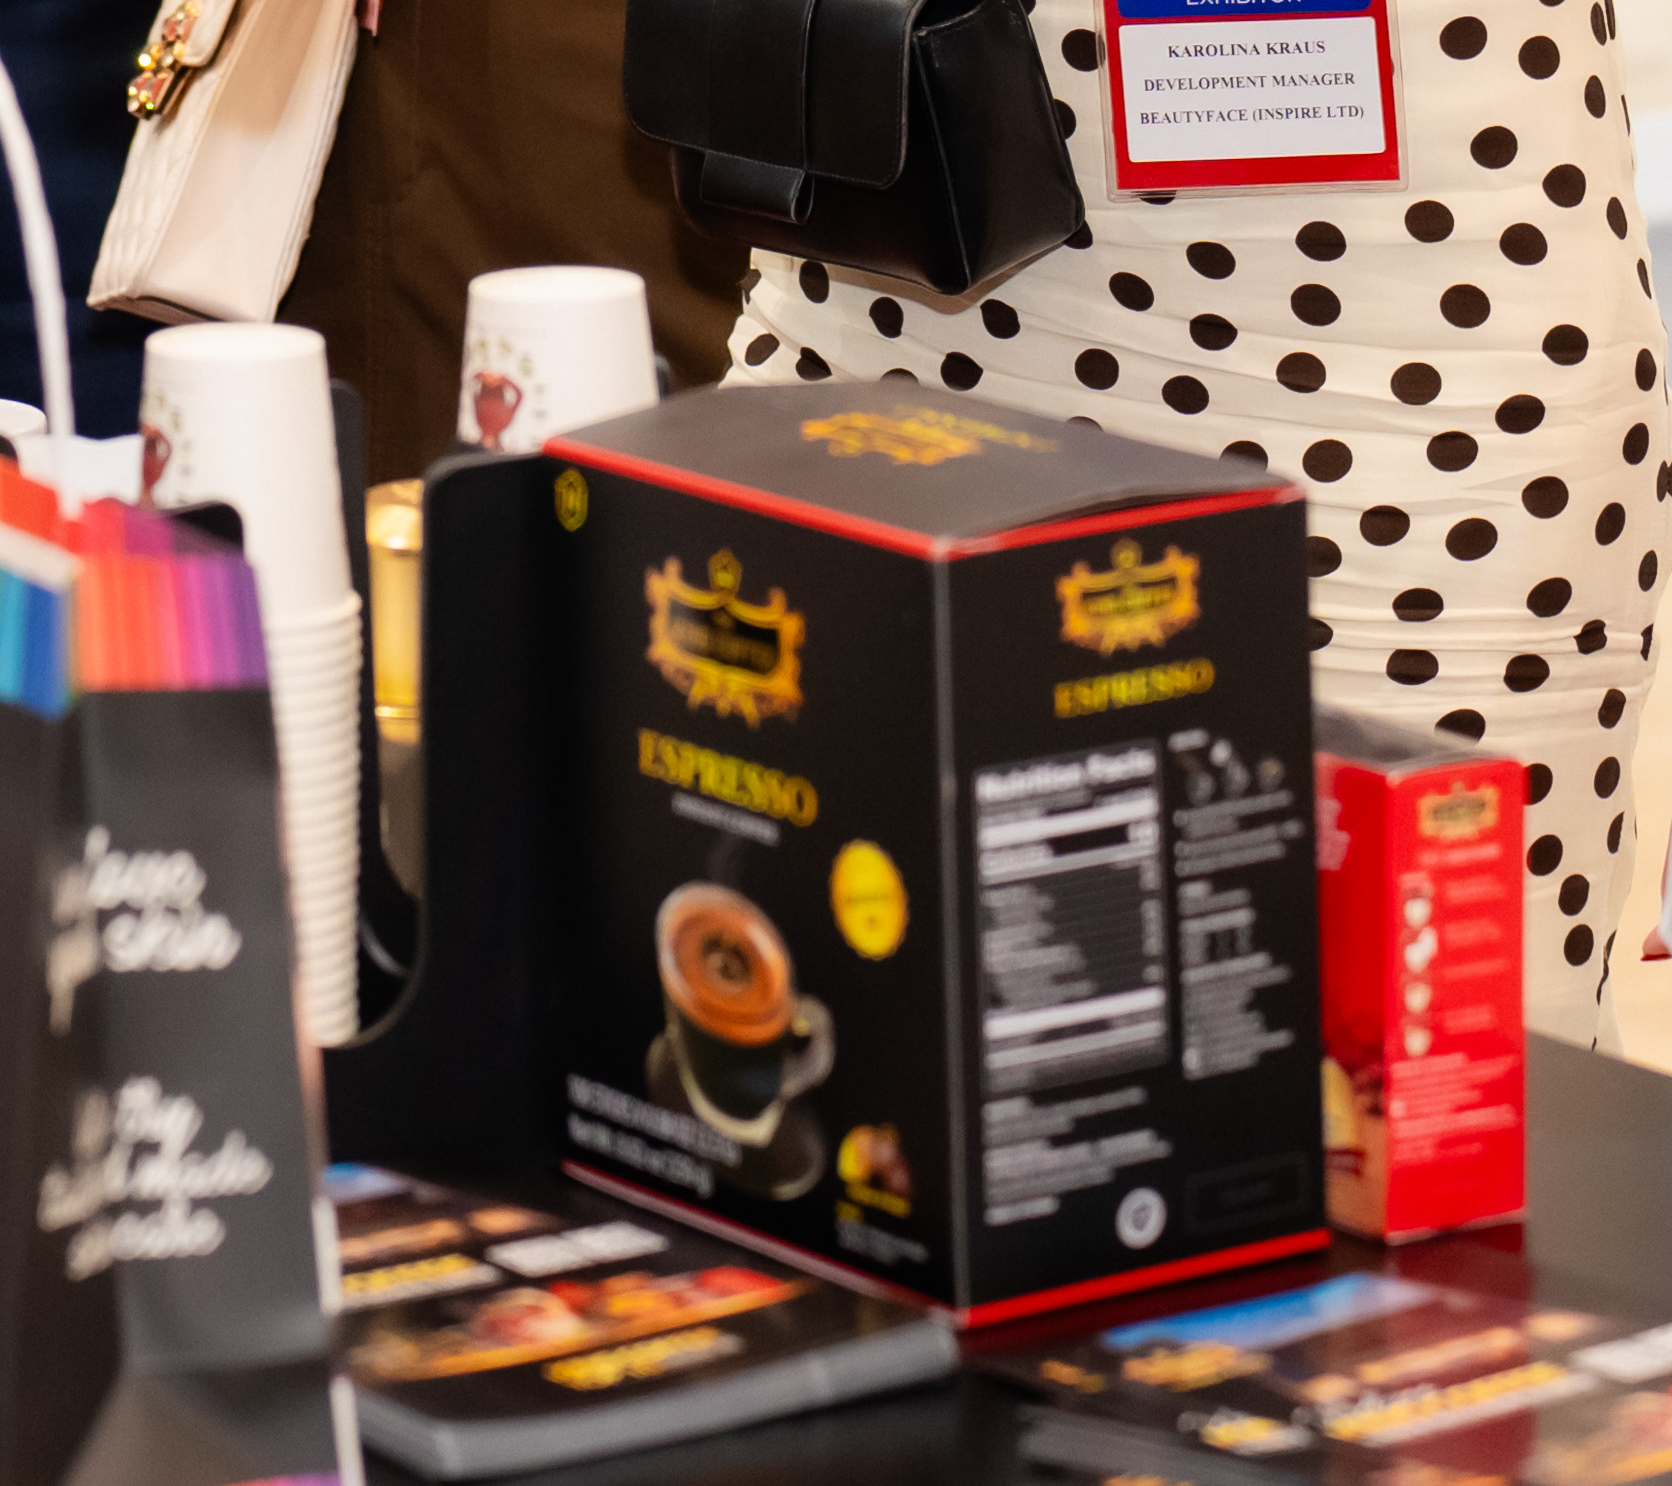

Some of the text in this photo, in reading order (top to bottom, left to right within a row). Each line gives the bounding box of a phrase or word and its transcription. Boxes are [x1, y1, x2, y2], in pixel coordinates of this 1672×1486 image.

[1168, 40, 1326, 58] KAROLINA KRAUS
[1144, 73, 1356, 92] DEVELOPMENT MANAGER
[1140, 105, 1365, 125] BEAUTYFACE (INSPIRE LTD)
[637, 727, 819, 827] ESPRESSO
